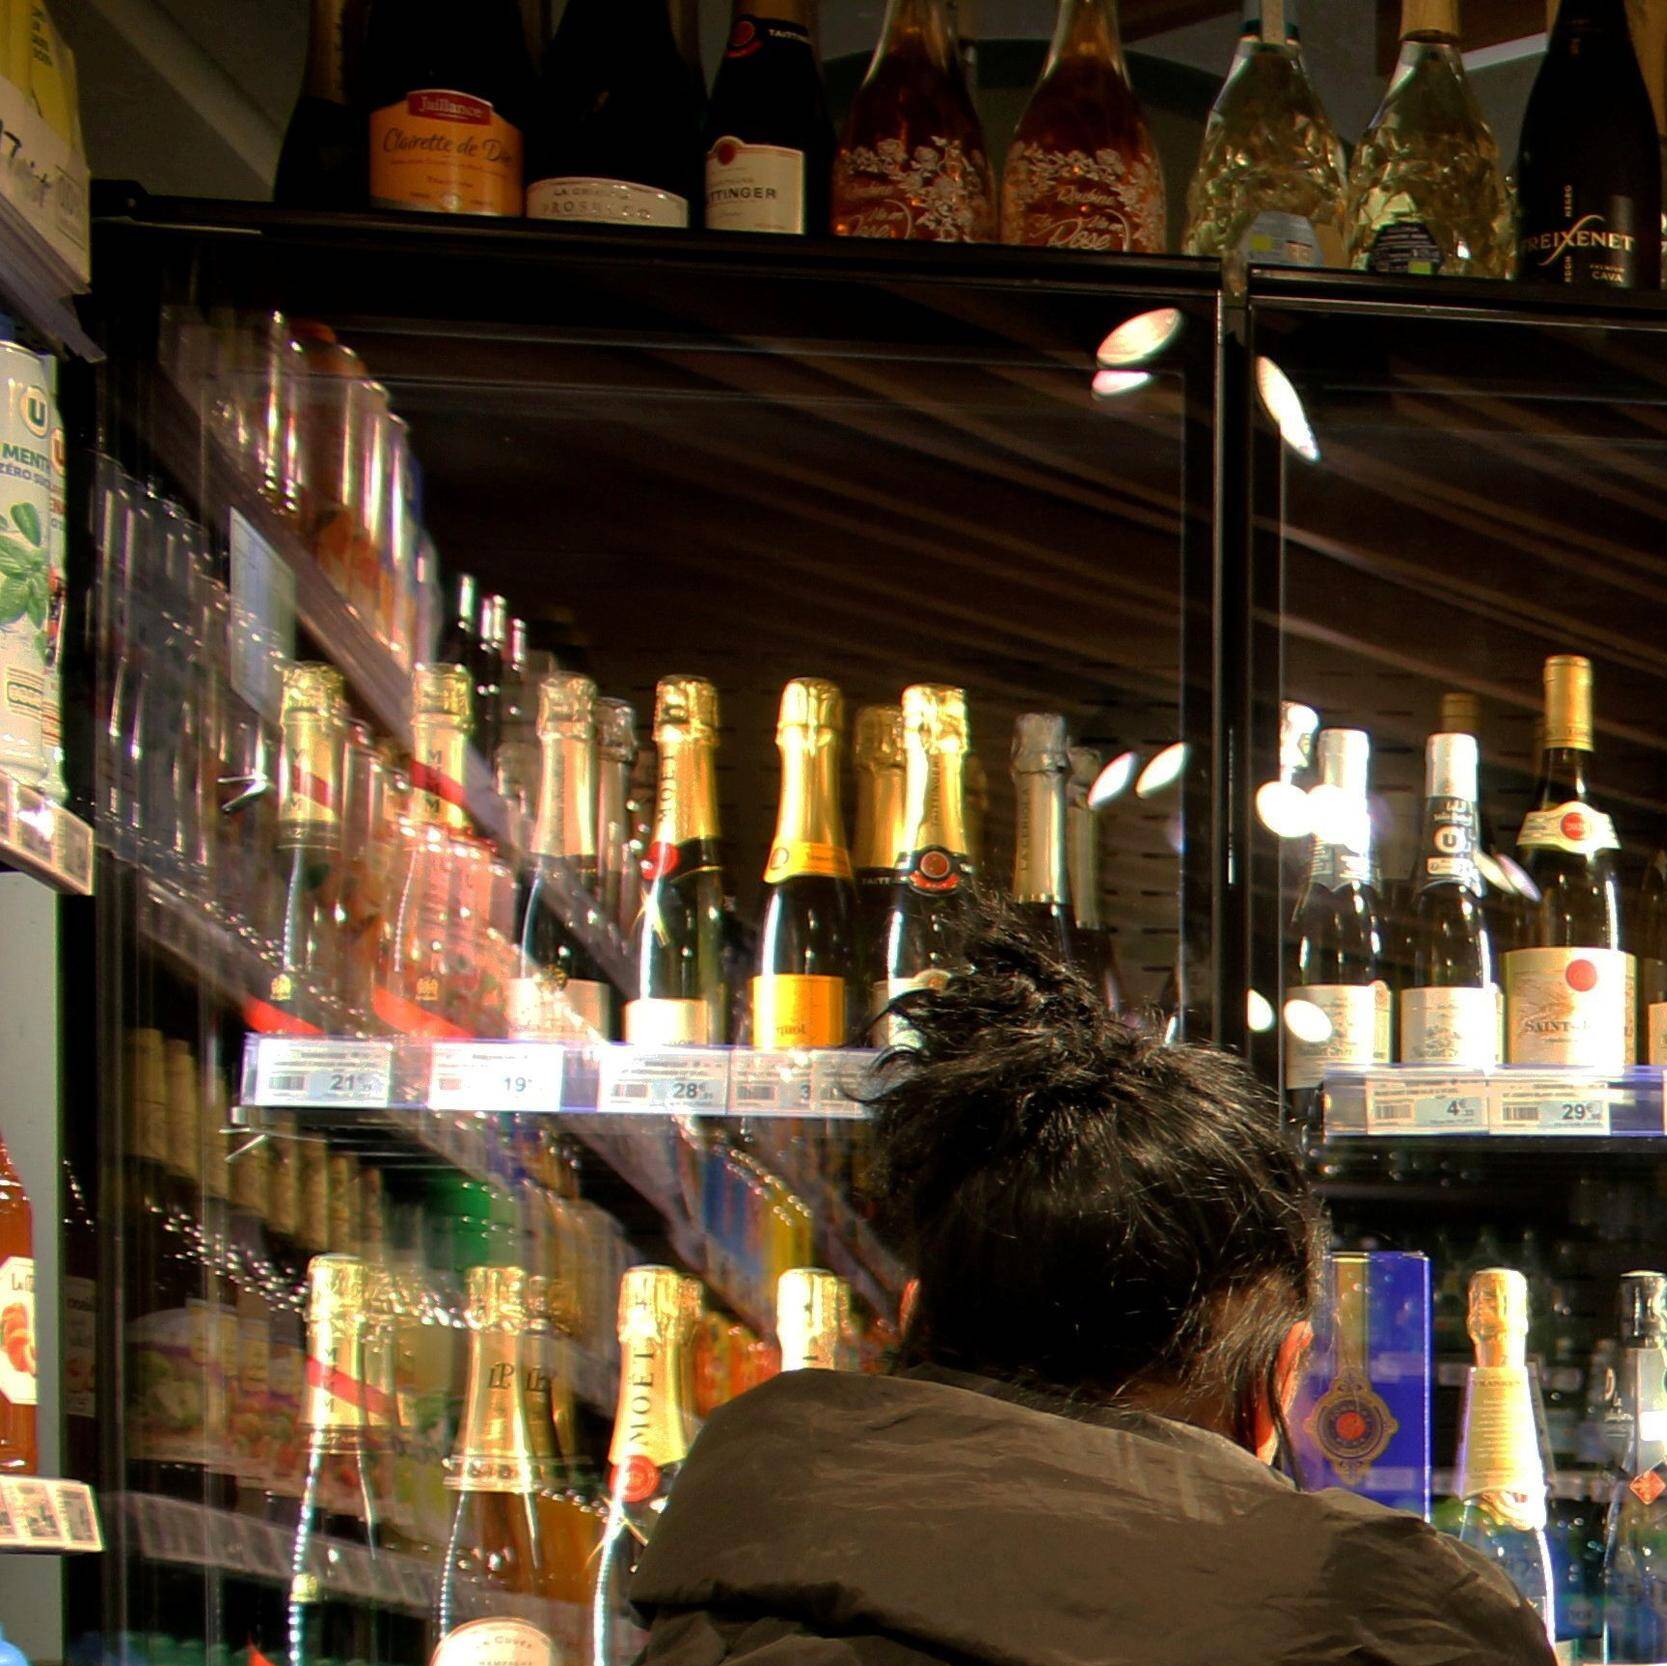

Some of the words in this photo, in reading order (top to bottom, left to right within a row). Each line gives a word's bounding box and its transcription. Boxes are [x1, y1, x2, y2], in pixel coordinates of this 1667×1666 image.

[382, 127, 453, 154] Clairette
[457, 136, 479, 155] de
[1526, 222, 1635, 259] REIXENET
